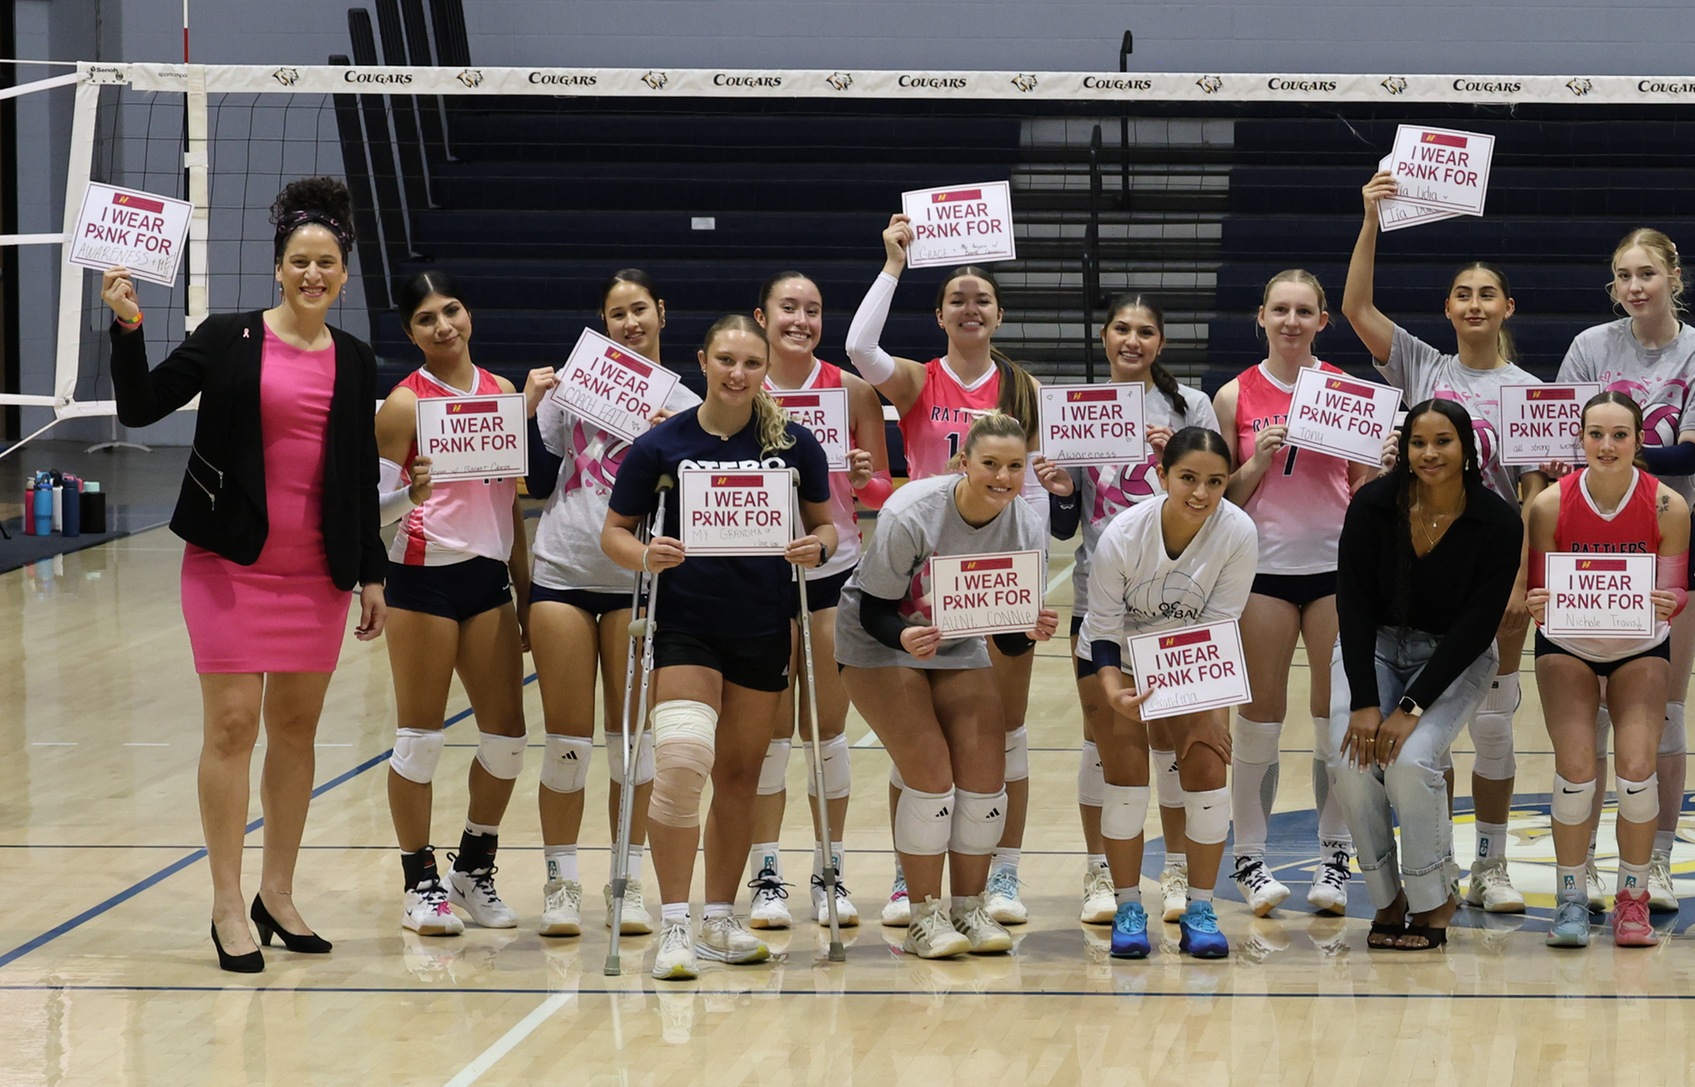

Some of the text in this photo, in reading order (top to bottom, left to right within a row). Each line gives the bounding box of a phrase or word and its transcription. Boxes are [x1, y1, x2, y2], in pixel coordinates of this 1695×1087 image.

[1421, 147, 1469, 168] WEAR
[1444, 168, 1478, 187] FOR
[935, 203, 989, 220] WEAR
[101, 207, 164, 234] I WEAR
[966, 219, 1002, 236] FOR
[134, 233, 172, 256] FOR
[920, 245, 948, 259] GRACE
[77, 243, 149, 266] AWARENESS
[590, 357, 649, 398] I WEAR
[563, 386, 629, 428] COACH FATI
[615, 391, 651, 420] FOR
[1070, 404, 1123, 421] WEAR
[1315, 390, 1375, 419] I WEAR
[1530, 403, 1581, 420] WEAR
[450, 416, 504, 434] WEAR
[1101, 422, 1136, 438] FOR
[1347, 417, 1383, 440] FOR
[1559, 421, 1577, 437] FO
[481, 434, 517, 451] FOR
[814, 428, 838, 444] OR
[1300, 427, 1324, 445] Tony
[1057, 449, 1117, 460] Awareness
[1513, 443, 1551, 457] all strong
[714, 491, 769, 507] WEAR
[745, 510, 782, 527] FOR
[692, 528, 762, 543] MY GRANDMA
[964, 572, 1018, 590] WEAR
[1578, 575, 1632, 591] WEAR
[995, 589, 1031, 606] FOR
[1608, 594, 1644, 610] FOR
[1566, 613, 1601, 628] Nichole
[1164, 644, 1220, 668] WEAR
[1198, 661, 1236, 682] FOR
[1150, 692, 1199, 710] Grandma
